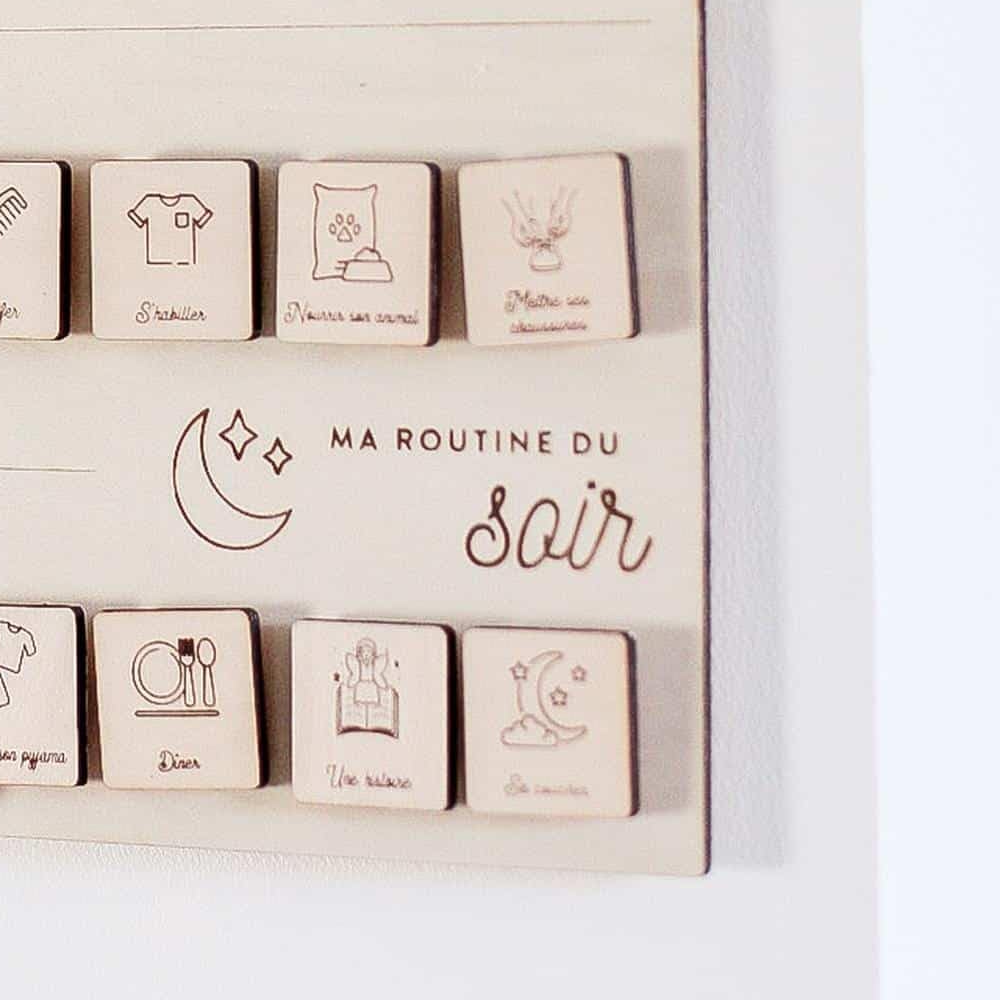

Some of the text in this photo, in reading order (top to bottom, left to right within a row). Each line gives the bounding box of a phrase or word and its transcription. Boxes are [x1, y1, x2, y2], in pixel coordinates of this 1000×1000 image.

[135, 300, 207, 324] S'habiller
[330, 425, 619, 455] MA ROUTINE DU
[465, 480, 653, 573] soir
[20, 749, 68, 771] pyjama
